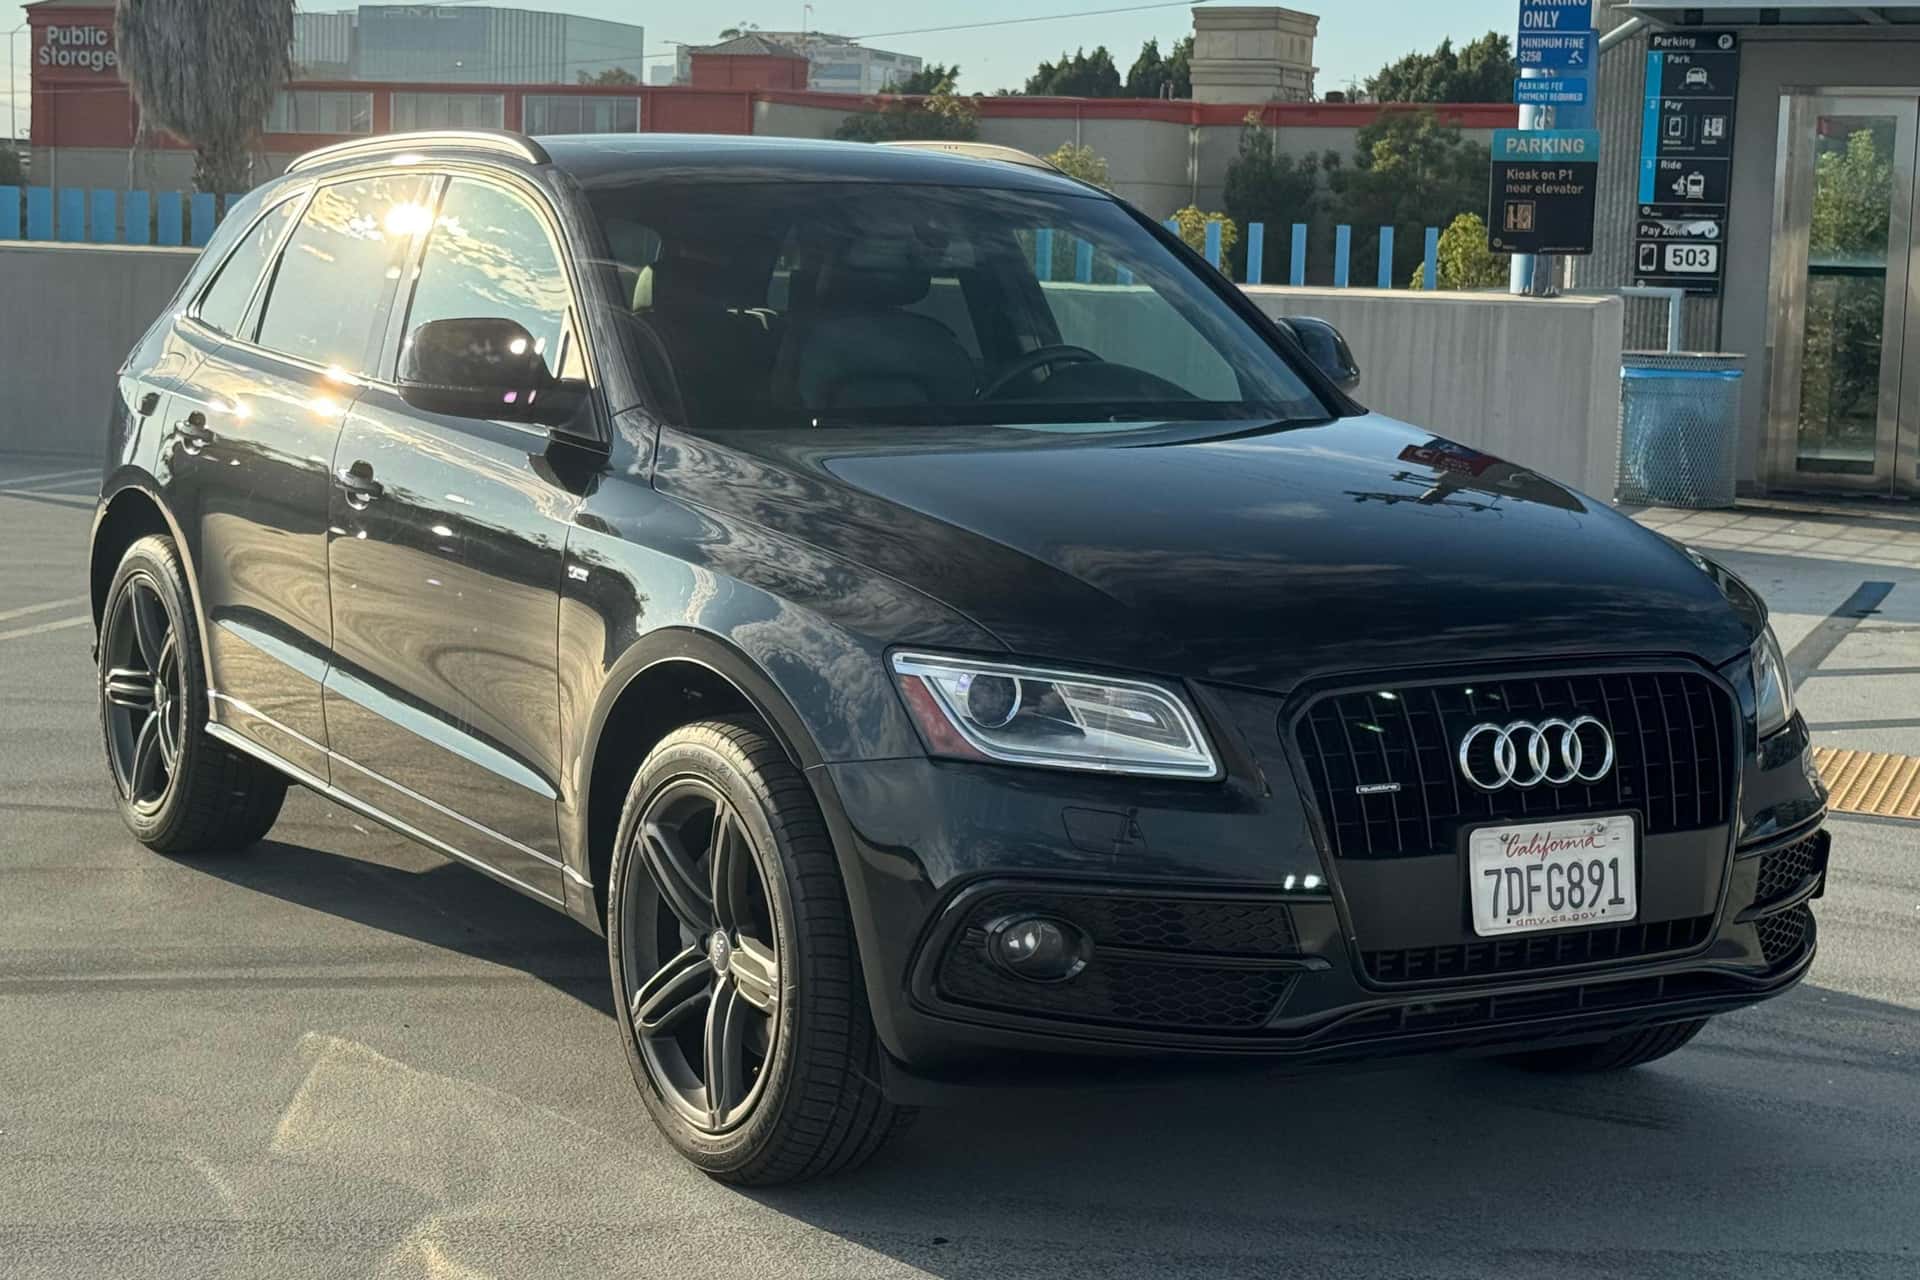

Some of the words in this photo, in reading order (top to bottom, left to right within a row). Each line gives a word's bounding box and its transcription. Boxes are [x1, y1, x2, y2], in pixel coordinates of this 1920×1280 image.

[1523, 10, 1560, 28] ONLY
[47, 25, 108, 46] Public
[1654, 36, 1696, 49] Parking
[1520, 37, 1562, 49] MINIMUM
[1564, 38, 1585, 49] FINE
[39, 45, 116, 72] Storage
[1667, 54, 1691, 64] Park
[1664, 100, 1682, 111] Pay
[1505, 137, 1585, 153] PARKING
[1660, 160, 1682, 169] Ride
[1506, 168, 1539, 180] Kiosk
[1541, 171, 1556, 180] on
[1558, 169, 1573, 180] P1
[1505, 184, 1533, 193] near
[1535, 183, 1584, 194] elevator
[1641, 225, 1661, 238] Pay
[1672, 248, 1710, 267] 503
[1506, 832, 1605, 861] California
[1484, 857, 1625, 919] 7DFG891
[1516, 911, 1597, 927] dmv.ca.gov
